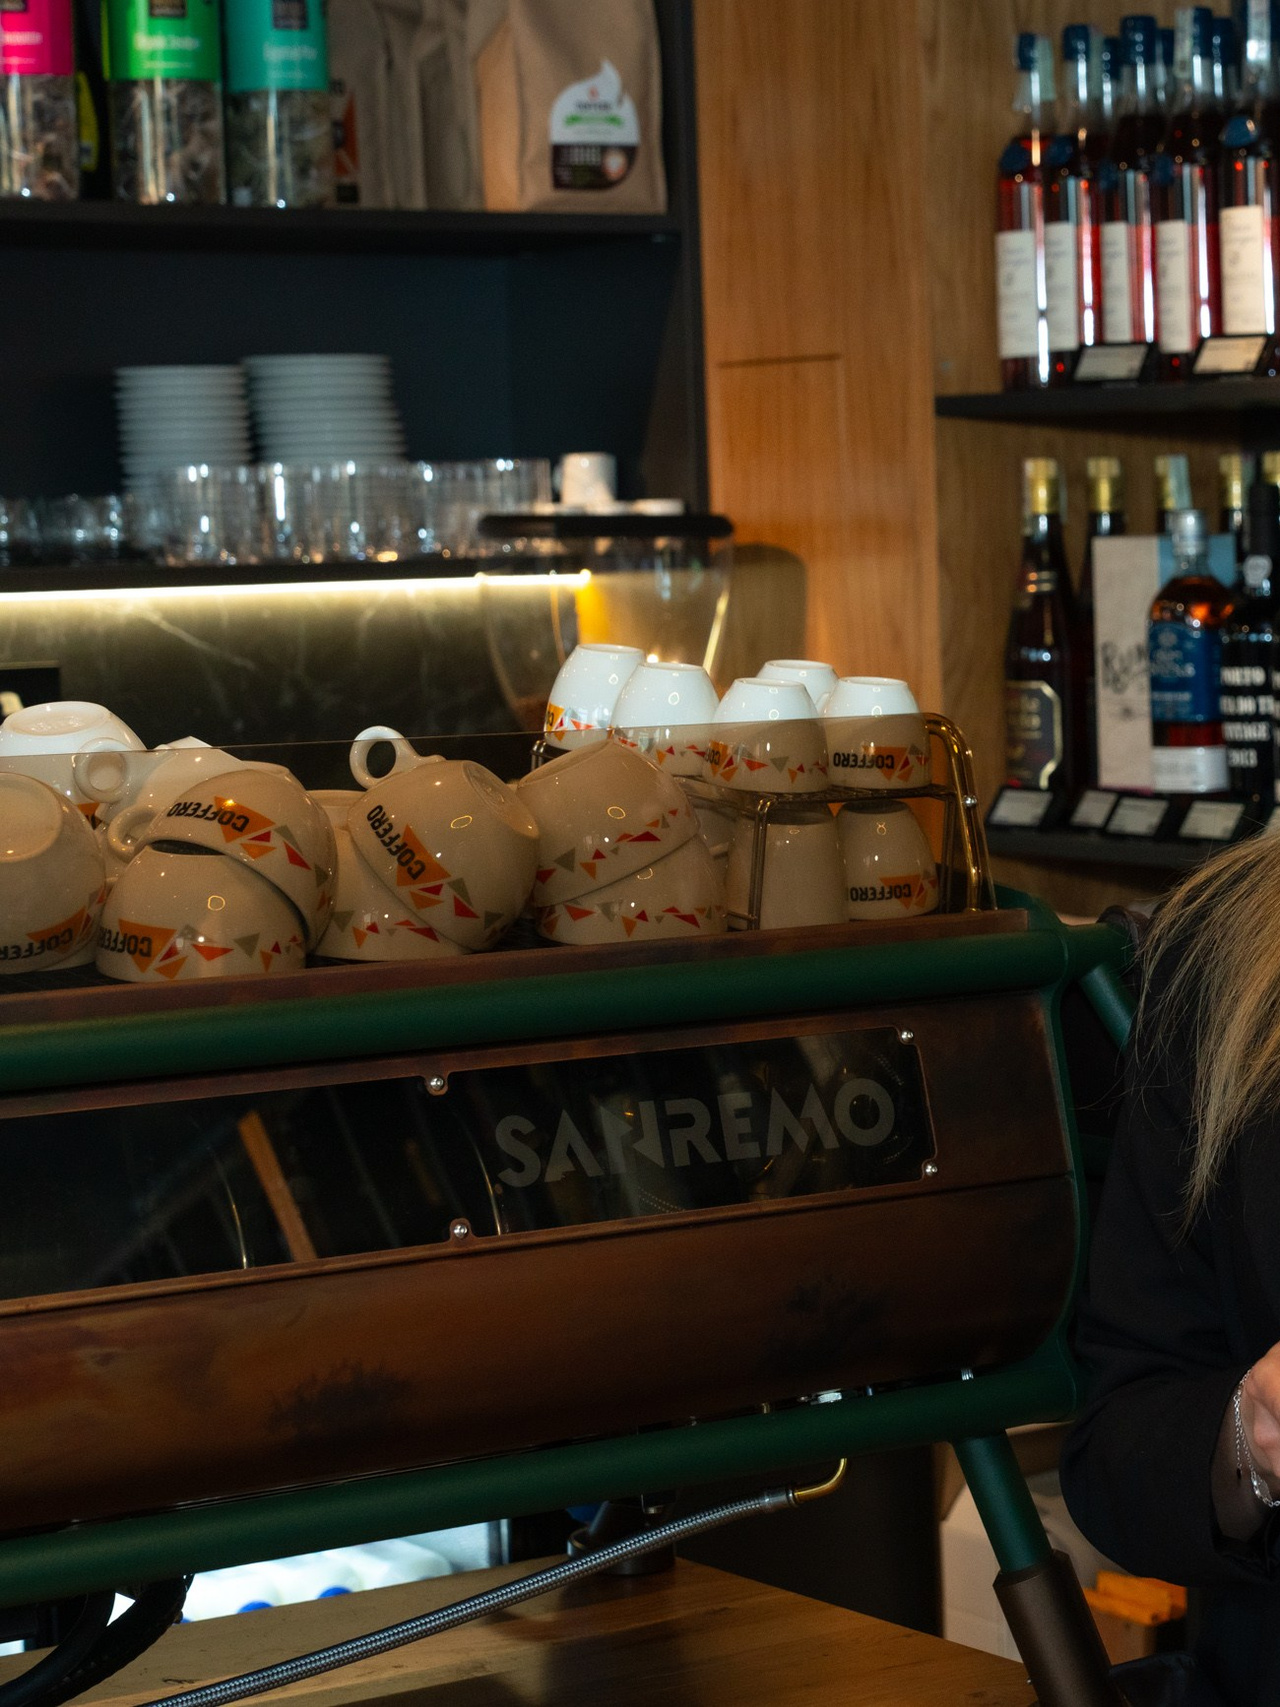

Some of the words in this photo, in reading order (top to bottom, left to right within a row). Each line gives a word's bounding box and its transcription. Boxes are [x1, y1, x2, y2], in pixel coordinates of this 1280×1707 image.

[833, 752, 894, 769] COFFERO
[167, 802, 250, 832] COFFERO
[367, 805, 426, 880] COFFERO
[850, 884, 911, 902] COFFERO
[495, 1078, 895, 1188] SANREMO
